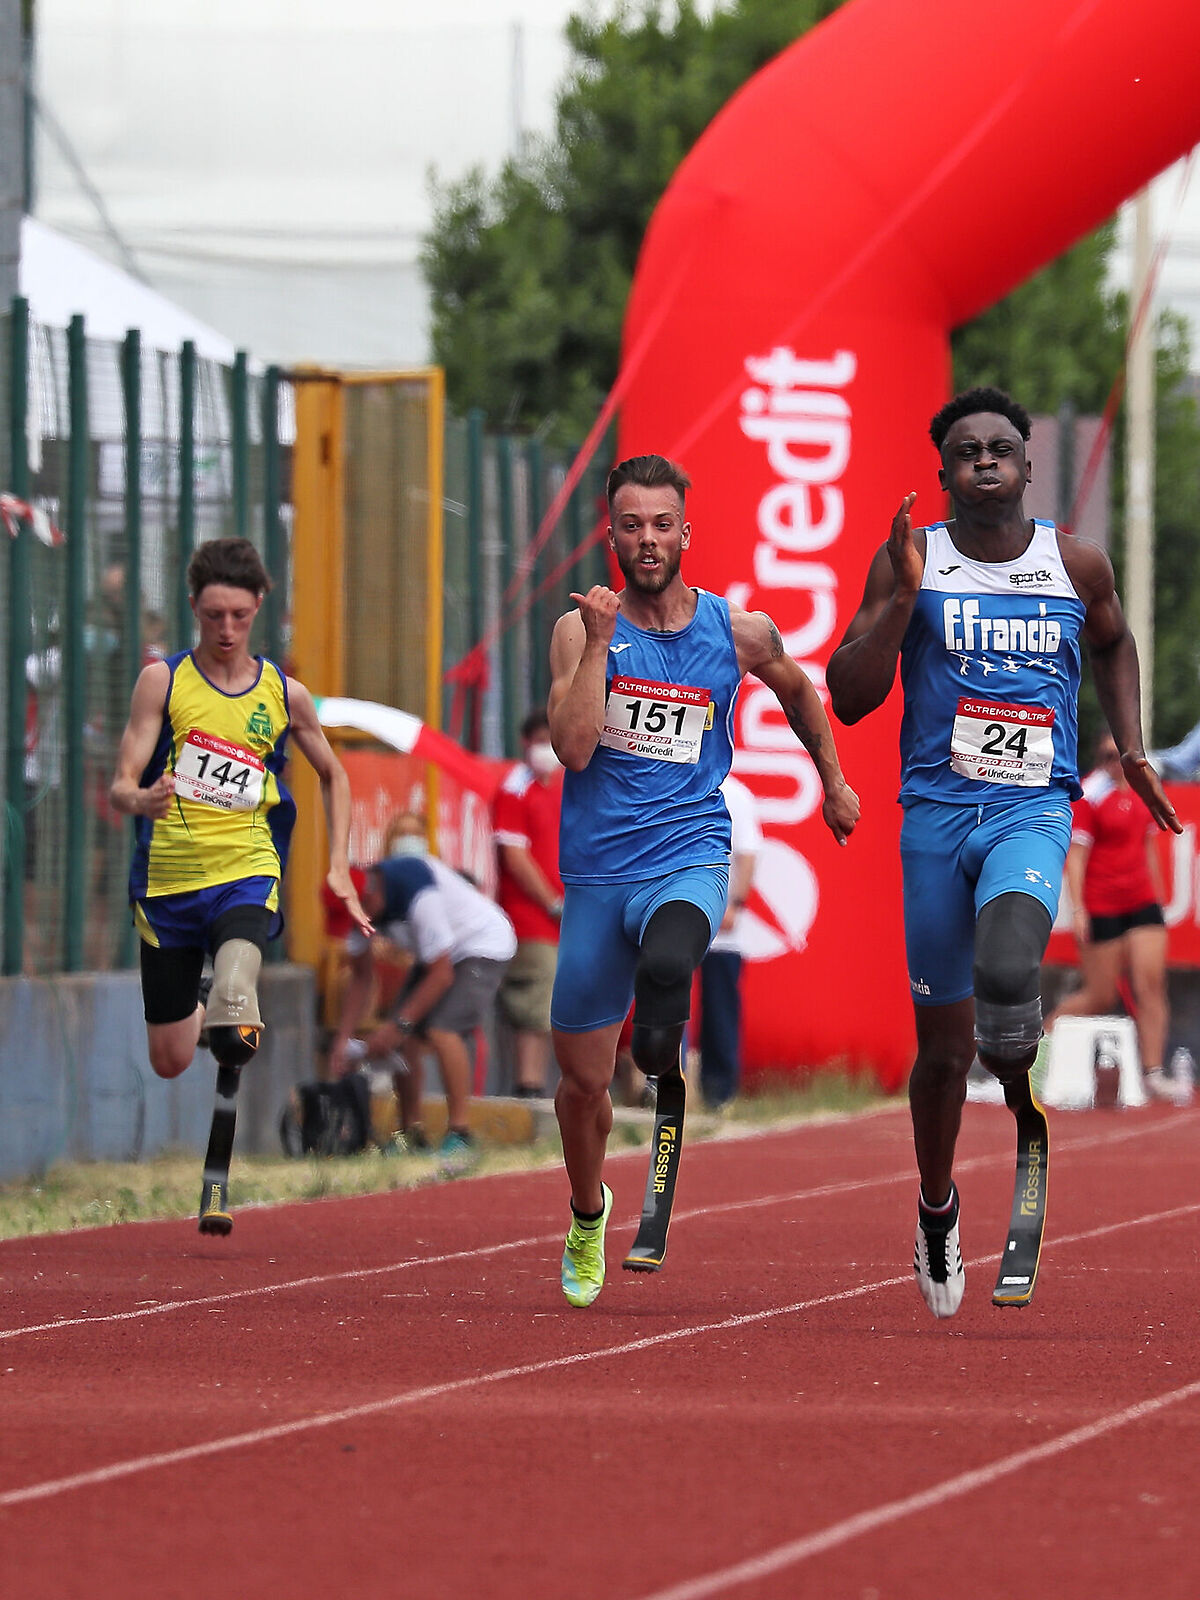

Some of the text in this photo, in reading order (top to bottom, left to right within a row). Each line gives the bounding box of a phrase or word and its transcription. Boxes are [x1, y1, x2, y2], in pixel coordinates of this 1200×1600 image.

[617, 681, 701, 701] OLTREMODOLTRE
[625, 699, 687, 736] 151
[963, 703, 1048, 722] OLTREMODOLTRE
[605, 727, 648, 742] CONCESIO
[981, 723, 1028, 759] 24
[637, 743, 674, 757] UniCredit
[953, 753, 998, 766] CONCESIO
[999, 759, 1022, 768] 2021
[197, 752, 251, 795] 144
[987, 769, 1025, 781] UniCredit
[201, 791, 233, 808] UniCredit
[652, 1144, 675, 1194] ÖSSUR
[1022, 1140, 1042, 1199] ÖSSUR
